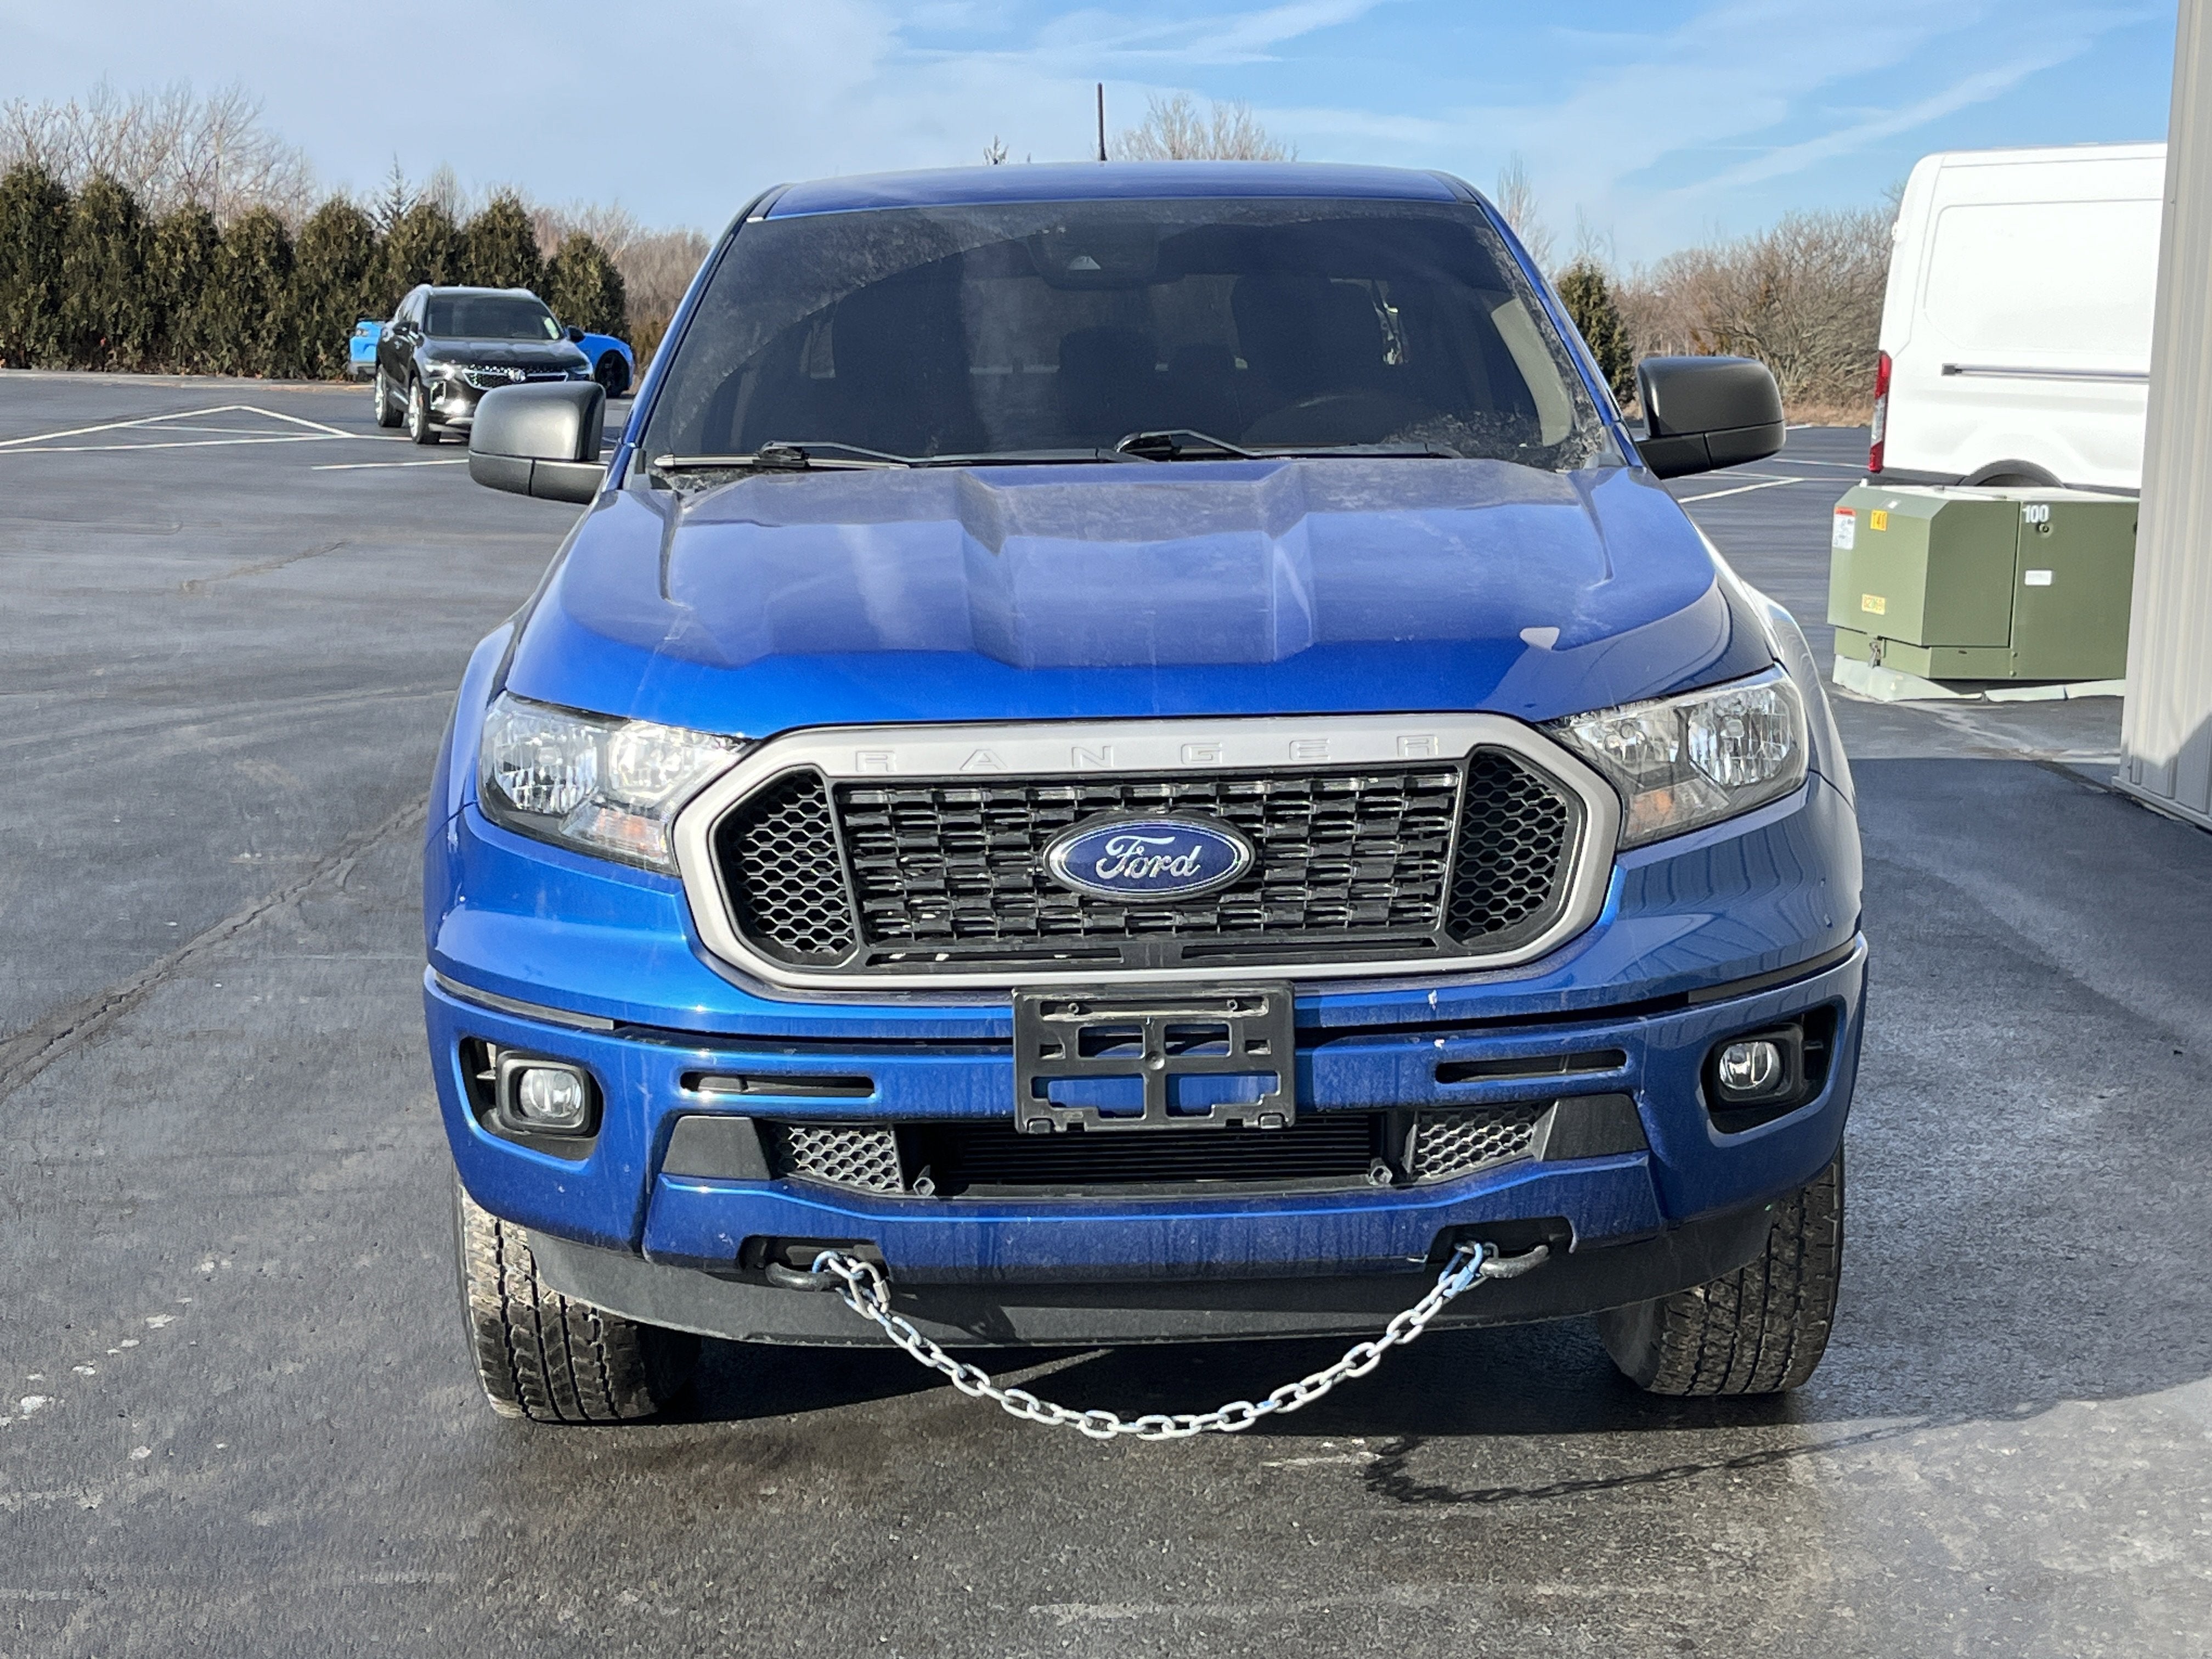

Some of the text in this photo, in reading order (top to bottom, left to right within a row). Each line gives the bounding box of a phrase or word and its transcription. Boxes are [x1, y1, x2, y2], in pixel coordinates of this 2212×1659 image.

[2022, 504, 2049, 523] 100
[855, 733, 1439, 772] RANGER
[1096, 834, 1201, 879] Ford
